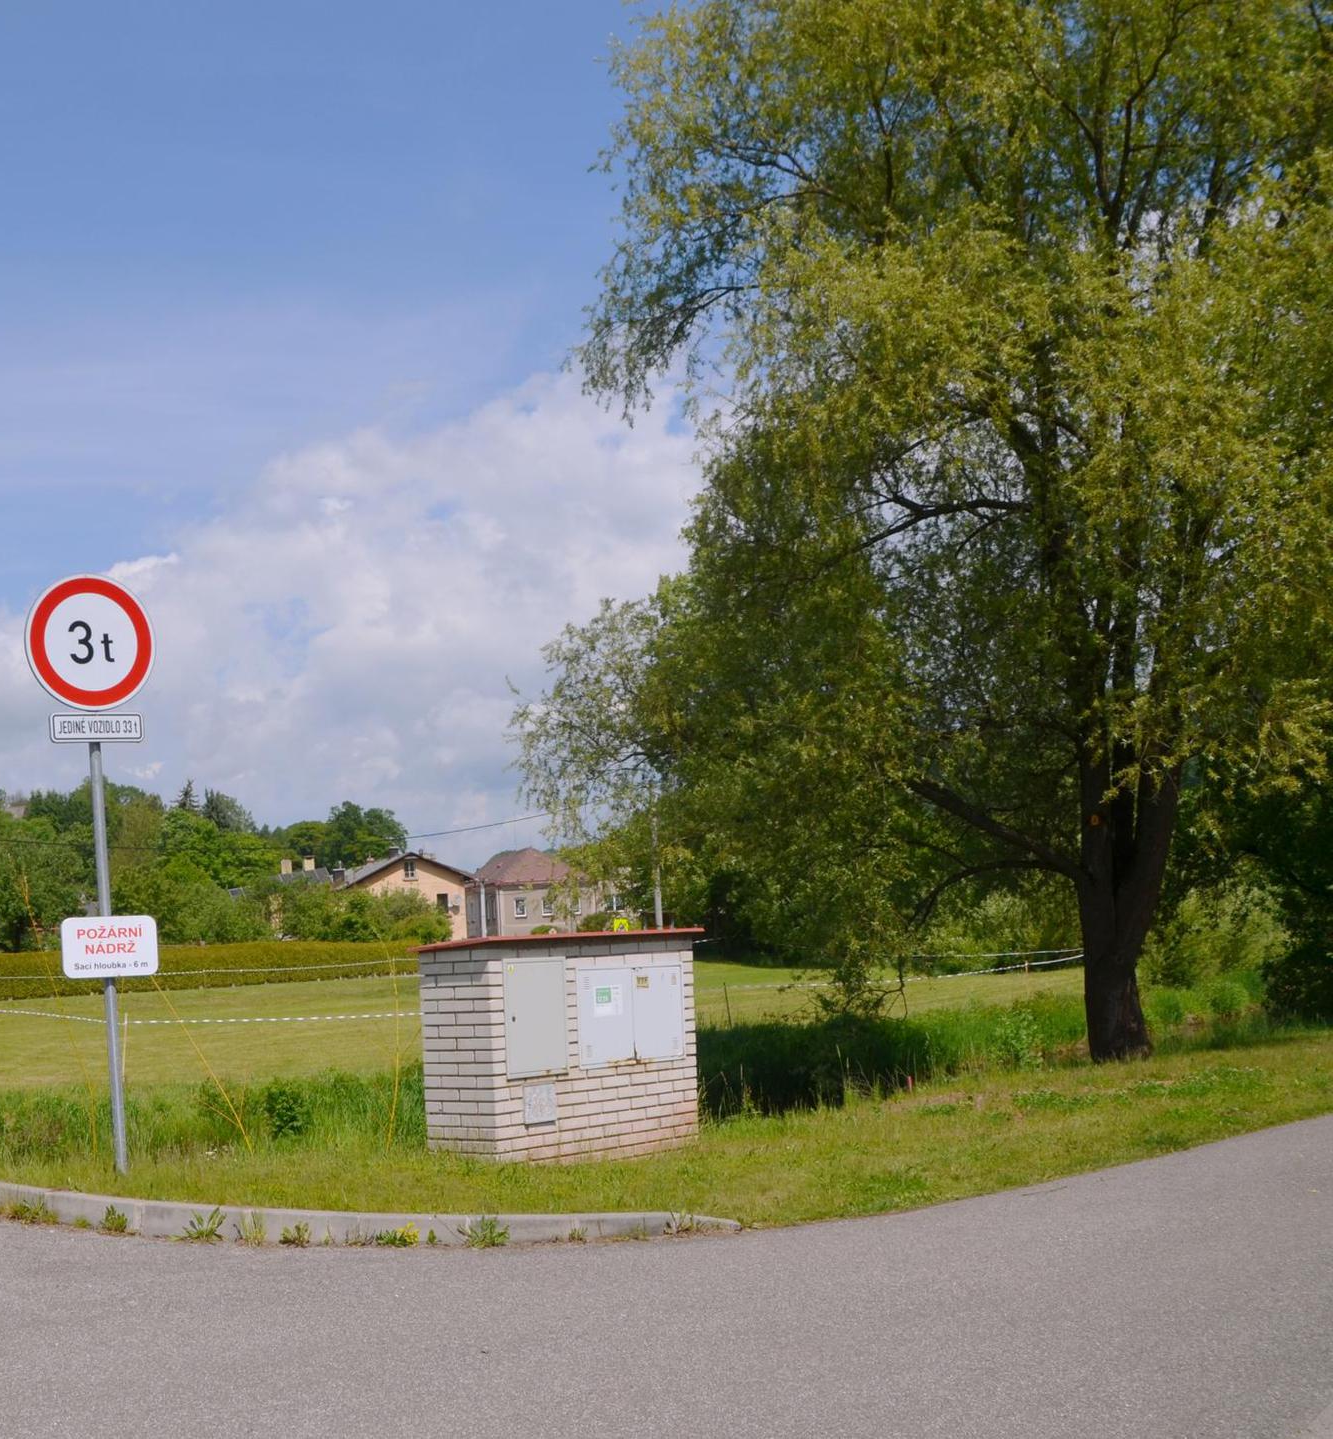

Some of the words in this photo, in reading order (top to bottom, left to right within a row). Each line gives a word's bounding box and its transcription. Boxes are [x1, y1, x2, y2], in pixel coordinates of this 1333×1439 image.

[59, 717, 86, 734] JEDINÉ
[88, 720, 121, 734] VOZIDLO
[123, 720, 133, 733] 33
[77, 924, 142, 940] POŽÁRNÍ
[85, 940, 136, 955] NÁDRŽ
[94, 961, 126, 970] hloubka
[133, 960, 139, 968] 6
